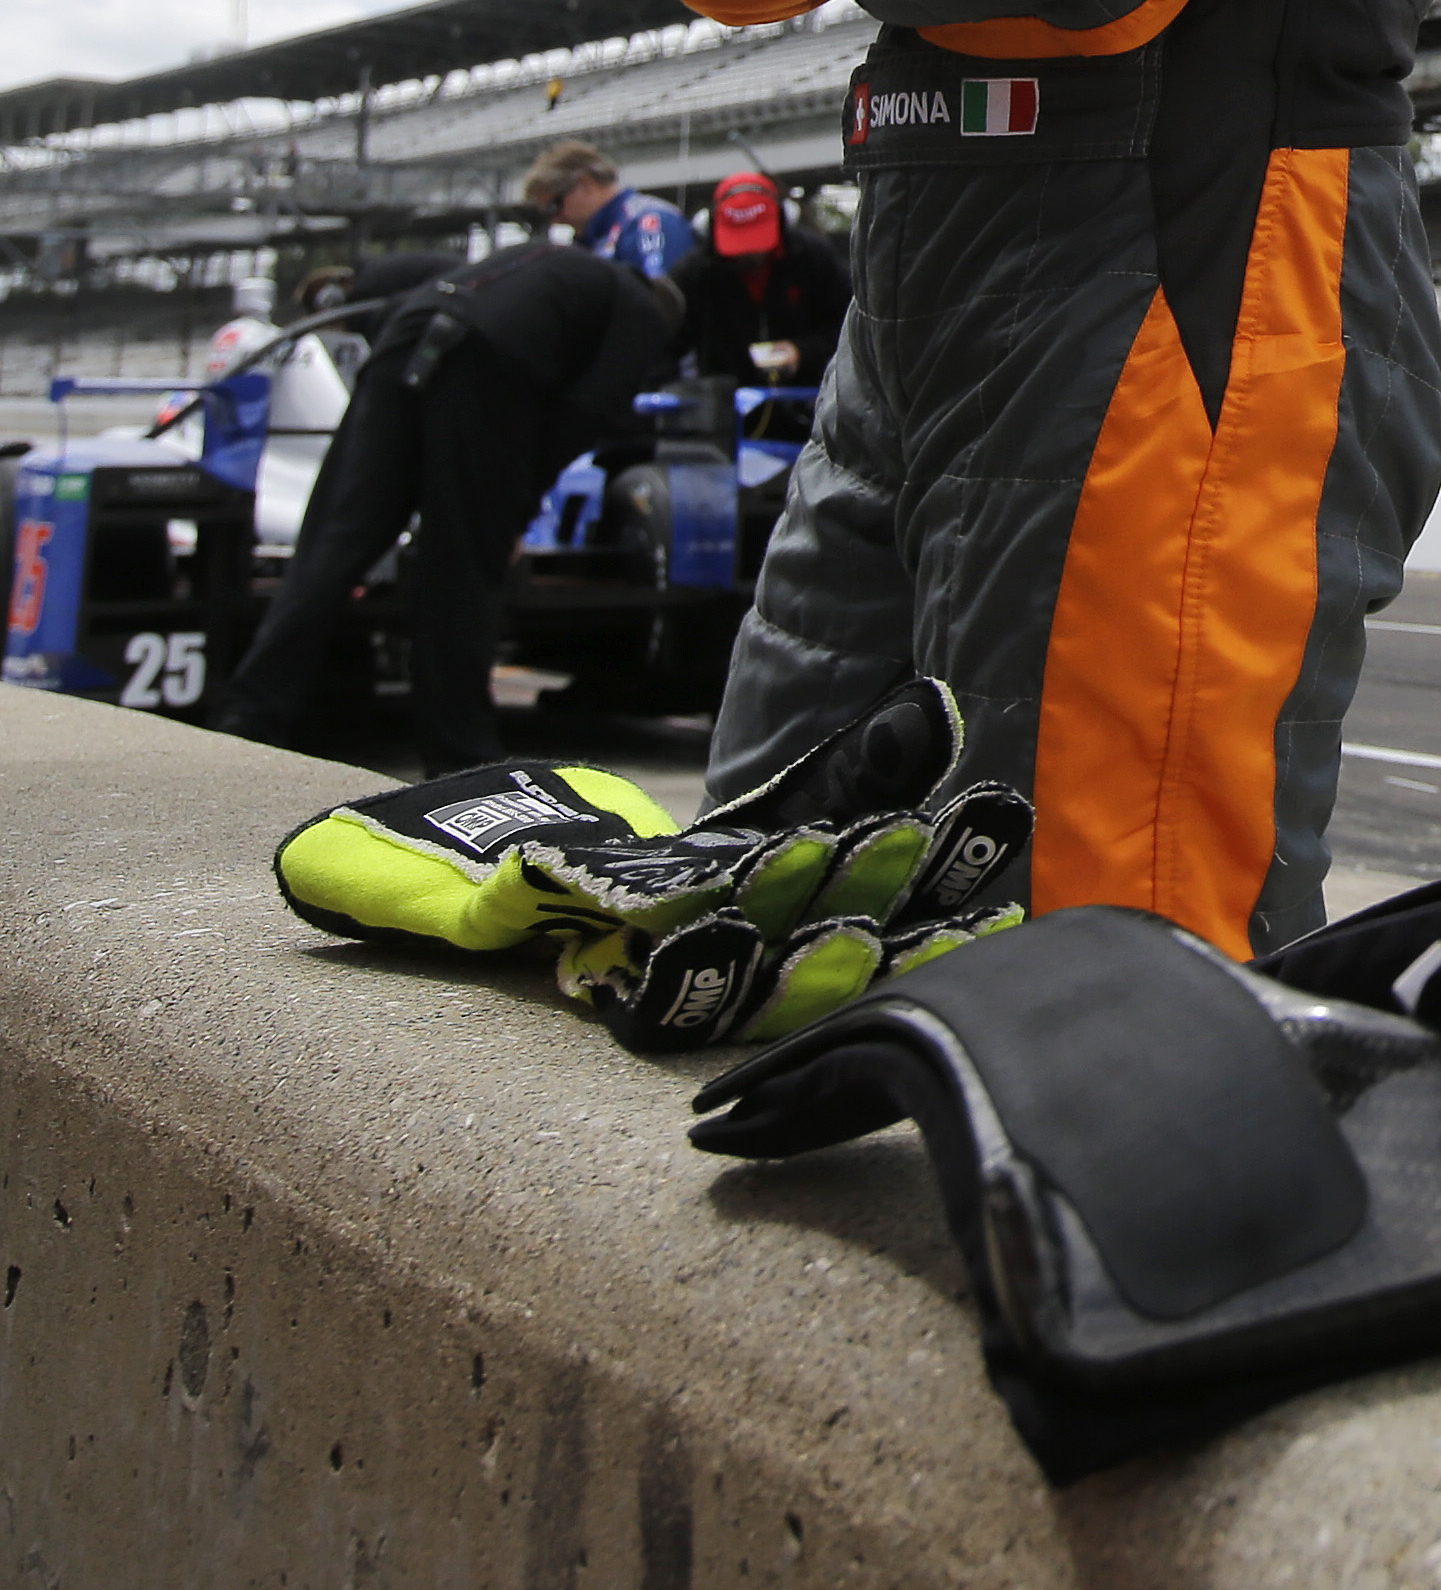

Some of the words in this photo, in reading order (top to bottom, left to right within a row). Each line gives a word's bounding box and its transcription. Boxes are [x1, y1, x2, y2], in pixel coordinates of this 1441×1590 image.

[870, 91, 950, 128] SIMONA
[121, 632, 206, 706] 25
[938, 834, 997, 906] OMP
[672, 967, 727, 1028] OMP
